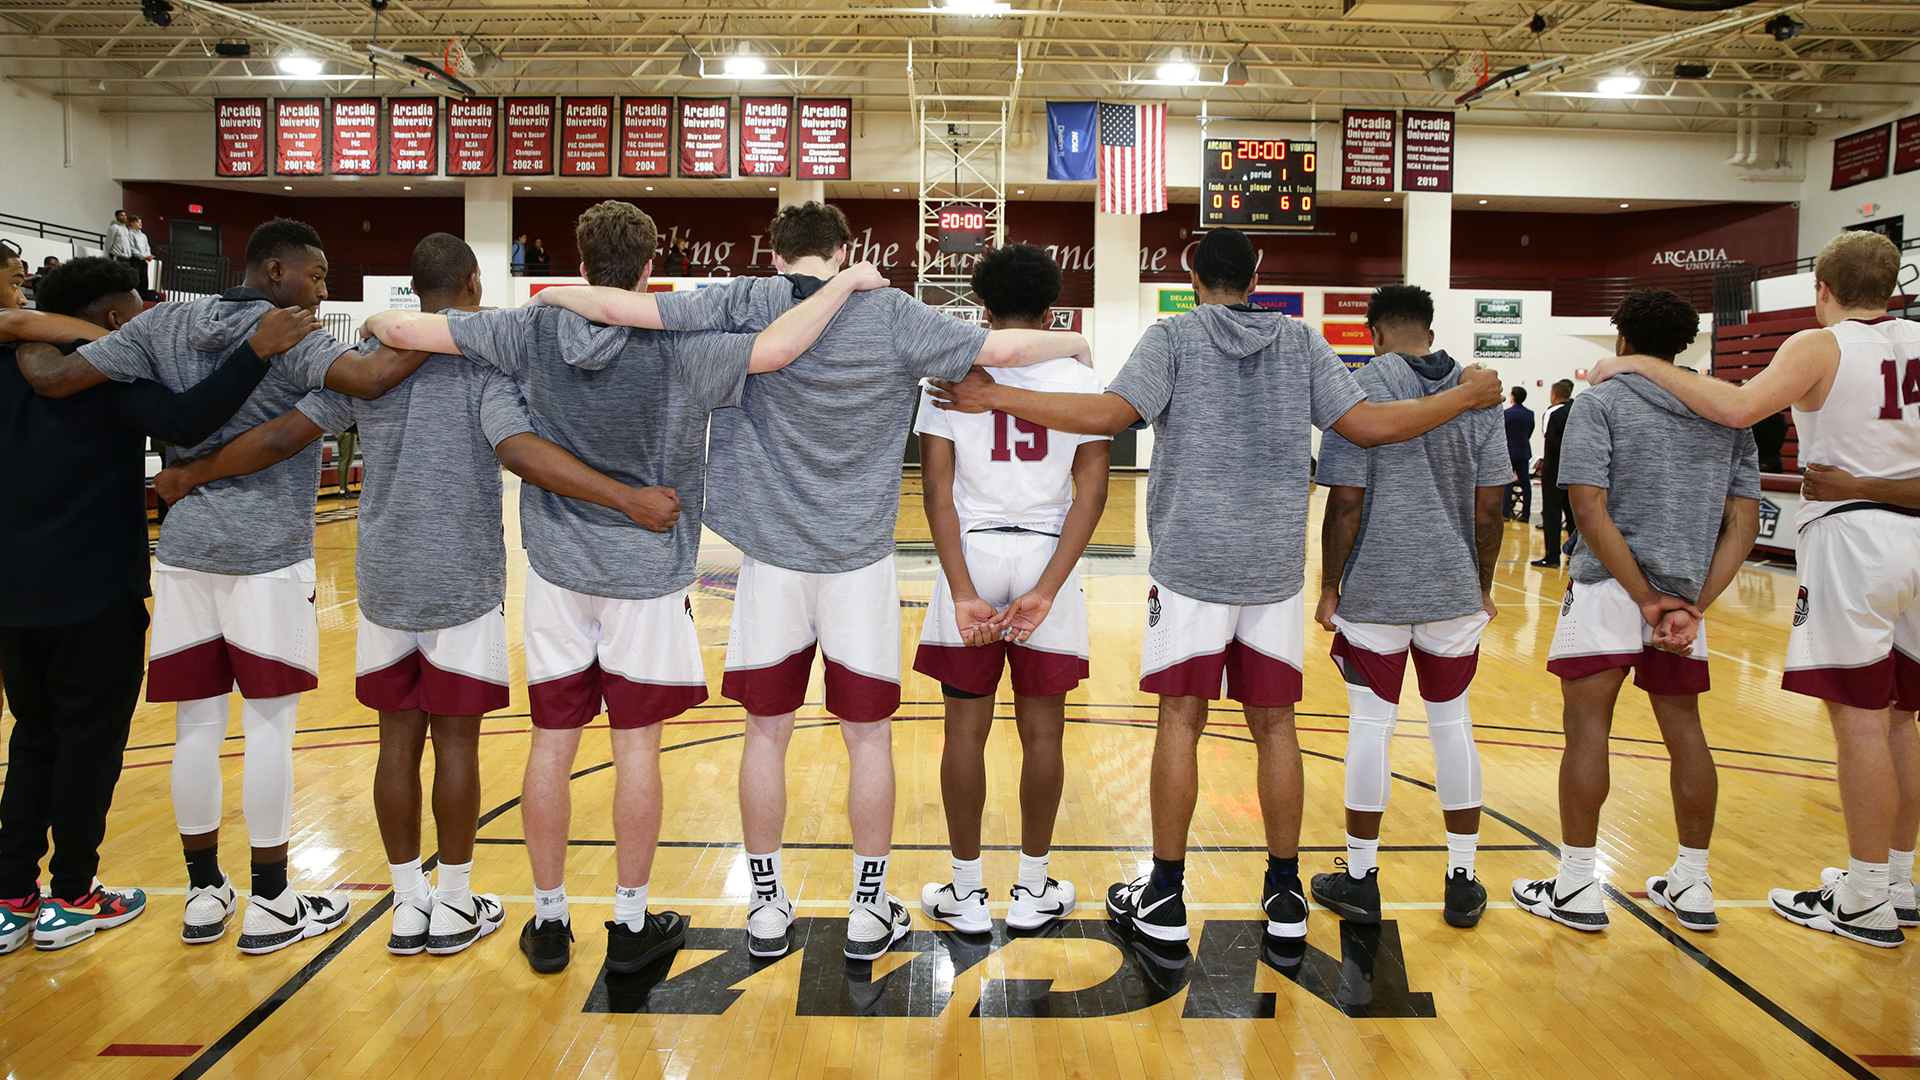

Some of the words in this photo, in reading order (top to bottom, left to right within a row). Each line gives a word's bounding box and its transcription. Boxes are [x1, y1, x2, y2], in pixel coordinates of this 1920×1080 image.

[220, 104, 262, 117] Arcadia
[280, 104, 320, 116] Arcadia
[336, 104, 376, 116] Arcadia
[393, 104, 432, 116] Arcadia
[452, 104, 492, 116] Arcadia
[510, 104, 550, 116] Arcadia
[566, 104, 608, 116] Arcadia
[626, 104, 667, 116] Arcadia
[684, 104, 726, 118] Arcadia
[746, 103, 788, 116] Arcadia
[802, 105, 847, 118] Arcadia
[220, 118, 262, 128] University
[280, 118, 320, 128] University
[336, 116, 376, 126] University
[393, 116, 433, 128] University
[451, 117, 492, 128] University
[509, 116, 550, 127] University
[566, 118, 607, 128] University
[625, 117, 667, 128] University
[684, 118, 726, 129] University
[745, 116, 787, 128] University
[802, 118, 846, 130] University
[1348, 116, 1391, 130] Arcadia
[1407, 117, 1450, 130] Arcadia
[1348, 130, 1391, 141] University
[1407, 130, 1450, 142] University
[1207, 140, 1232, 150] ARCADIA
[1238, 140, 1286, 160] 20:00
[1290, 143, 1315, 152] VISITORS
[1424, 146, 1450, 154] Volleyball
[232, 161, 251, 171] 2001
[284, 160, 316, 170] 2001-02
[340, 160, 370, 170] 2001-02
[397, 160, 428, 170] 2001-02
[462, 160, 481, 170] 2002
[513, 160, 543, 170] 2002-03
[576, 162, 596, 171] 2004
[636, 161, 656, 170] 2004
[1221, 152, 1232, 170] 0
[1304, 154, 1315, 172] 0
[694, 162, 714, 172] 2006
[754, 162, 775, 172] 2017
[812, 164, 836, 175] 2018
[1250, 170, 1272, 180] period
[1282, 168, 1286, 180] 1
[1351, 175, 1386, 186] 2018-19
[1417, 176, 1438, 186] 2019
[1208, 182, 1224, 191] fouls
[1250, 184, 1272, 192] player
[1297, 185, 1312, 193] fouls
[1213, 194, 1222, 208] 0
[1231, 194, 1240, 209] 6
[1281, 196, 1290, 210] 6
[1302, 196, 1311, 210] 0
[941, 213, 983, 229] 20:00
[849, 228, 899, 268] the
[1652, 248, 1727, 268] ARCADIA
[398, 287, 415, 295] MA
[857, 860, 886, 904] ELITE
[581, 917, 1438, 1018] NCAA
